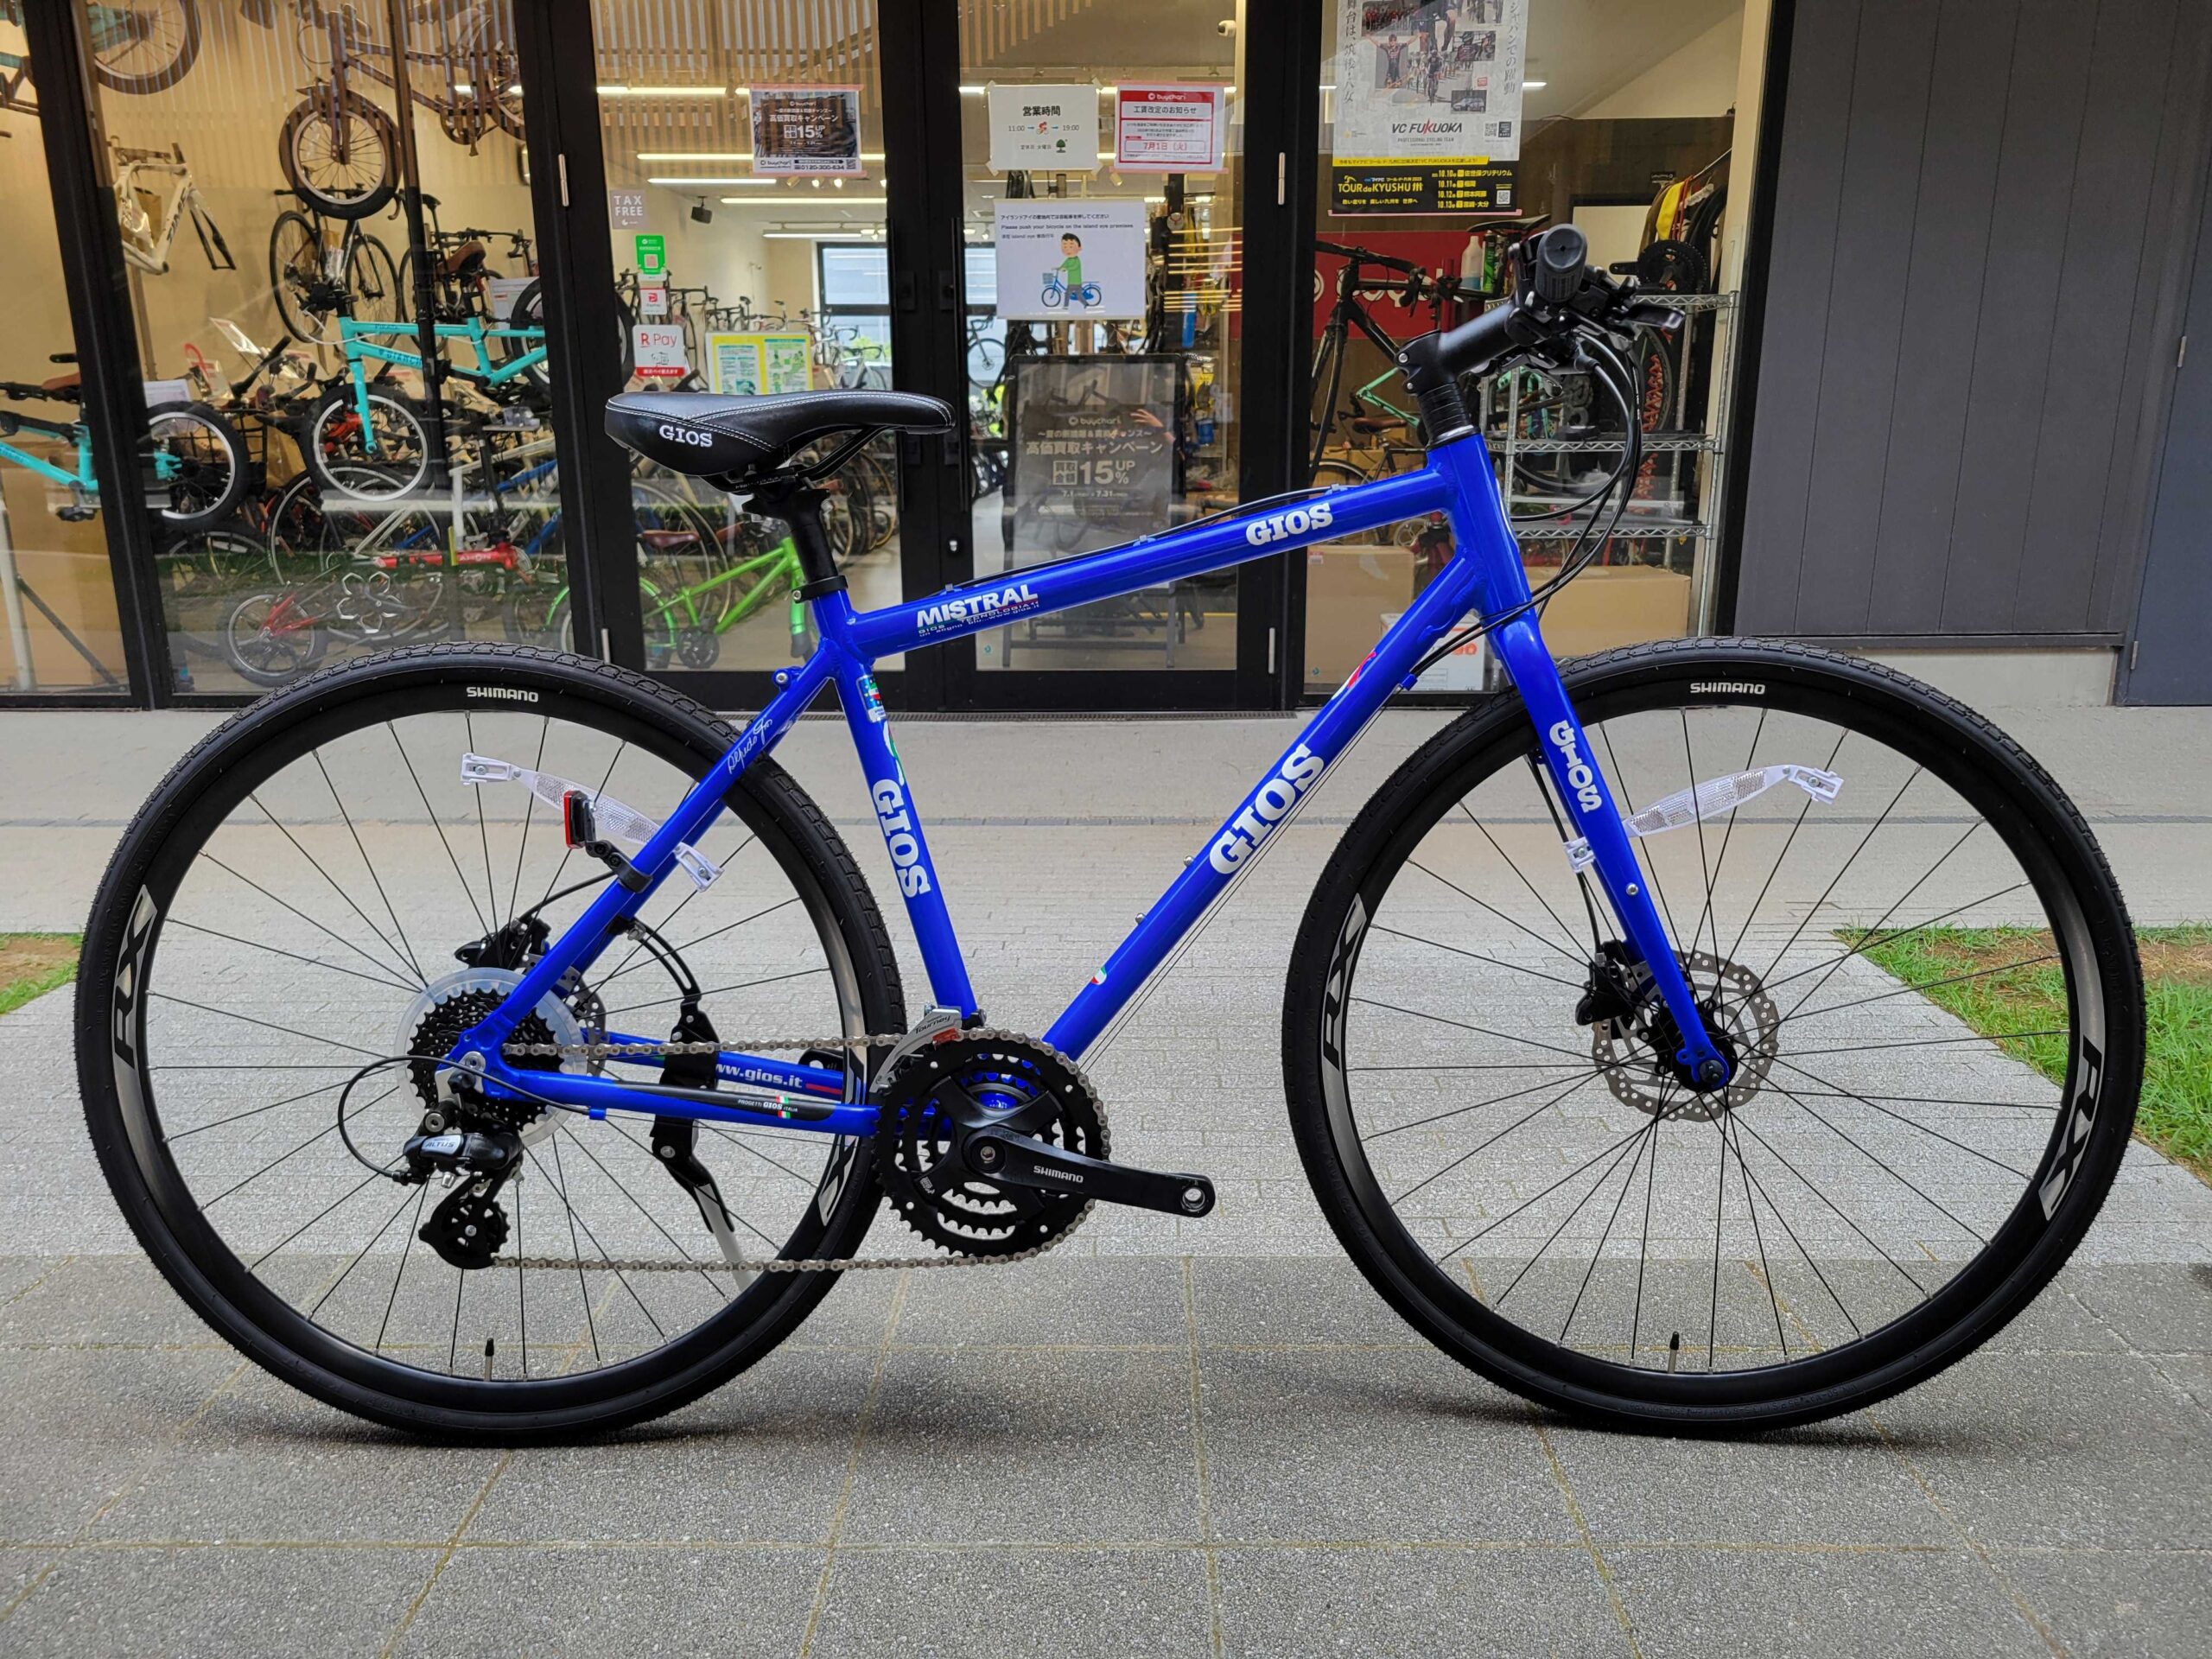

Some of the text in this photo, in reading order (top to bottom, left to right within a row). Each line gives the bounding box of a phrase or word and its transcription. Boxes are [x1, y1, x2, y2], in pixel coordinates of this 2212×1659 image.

[1022, 105, 1062, 117] 営業時間
[1133, 105, 1197, 114] 工賃改定のお知らせ
[797, 124, 815, 138] 15
[1392, 118, 1463, 135] VC FUKUOKA
[1338, 182, 1363, 193] TOUR
[1372, 182, 1411, 193] KYUSHU
[613, 195, 642, 205] TAX
[614, 207, 644, 216] FREE
[640, 333, 677, 347] R Pay
[659, 424, 713, 448] GIOS
[1026, 440, 1162, 455] 高価買取キャンペーン
[1080, 460, 1114, 485] 15
[1116, 460, 1135, 471] UP
[1116, 472, 1129, 485] %
[1246, 502, 1333, 546] GIOS
[917, 583, 1039, 628] MISTRAL
[918, 625, 945, 634] GIOS
[467, 687, 539, 702] SHIMANO
[1690, 682, 1765, 695] SHIMANO
[1549, 720, 1603, 814] GIOS
[1210, 743, 1325, 874] GIOS
[872, 779, 931, 899] GIOS
[916, 1015, 950, 1034] Tourney
[715, 1063, 803, 1089] ww.gios.it
[763, 1101, 783, 1109] GIOS
[1033, 1165, 1084, 1184] SHIMANO
